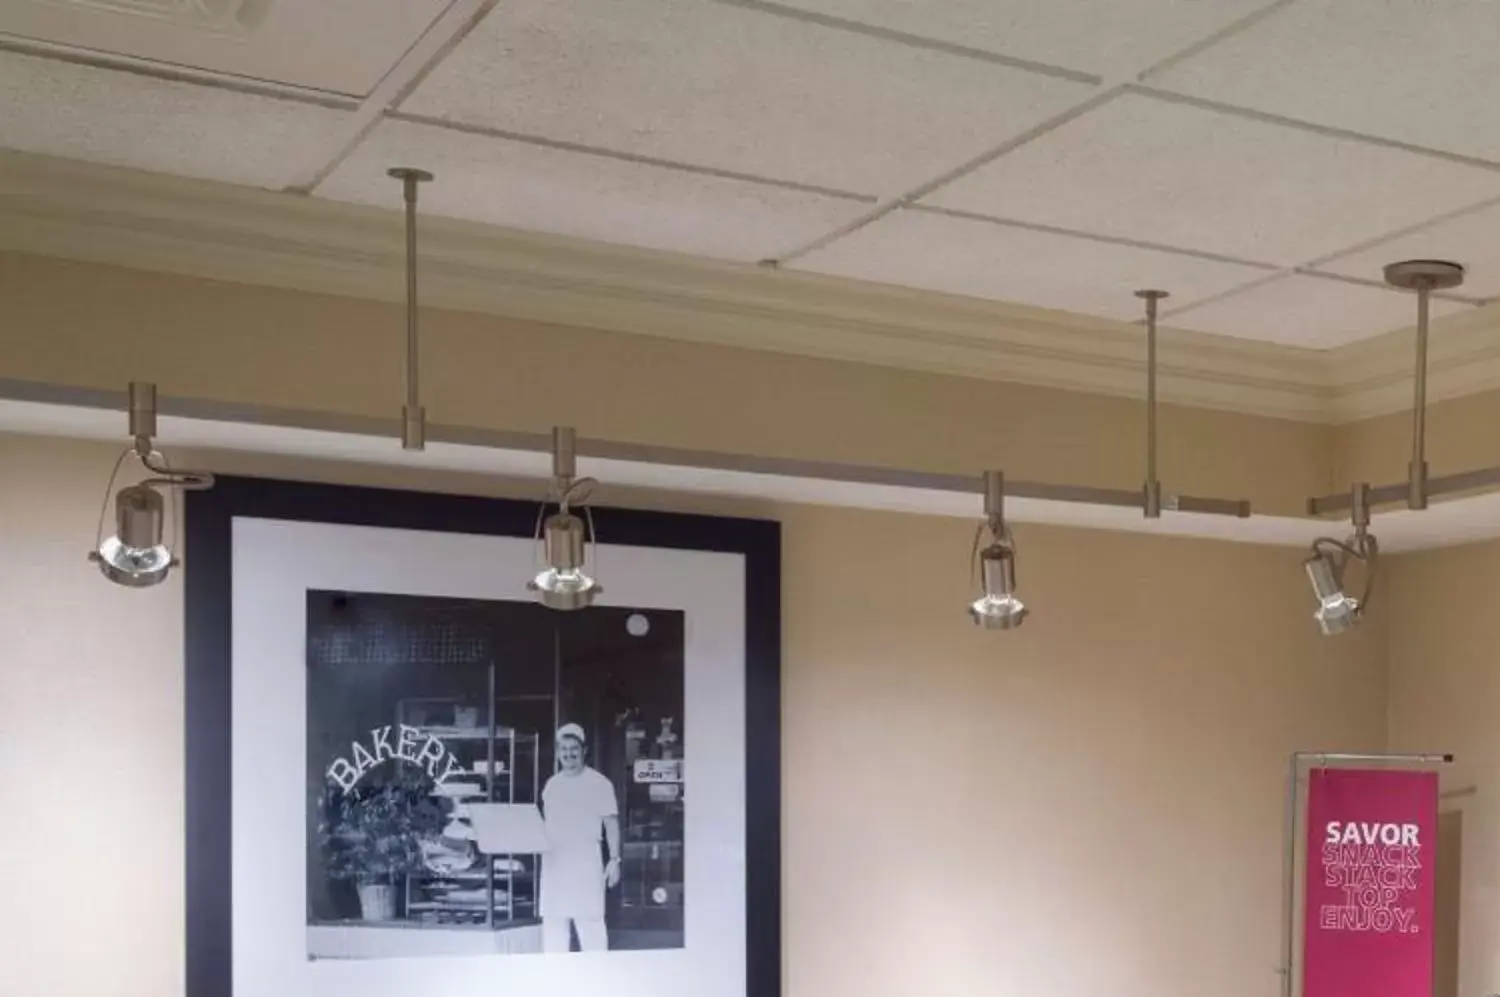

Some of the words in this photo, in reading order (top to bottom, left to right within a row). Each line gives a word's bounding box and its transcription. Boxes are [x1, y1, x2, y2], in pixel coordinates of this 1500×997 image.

[326, 723, 466, 795] BAKERY
[1325, 820, 1421, 846] SAVOR
[1321, 843, 1422, 868] SNACK
[1325, 863, 1418, 889] STACK
[1342, 880, 1399, 910] TOP
[1319, 904, 1419, 933] ENJOY.
